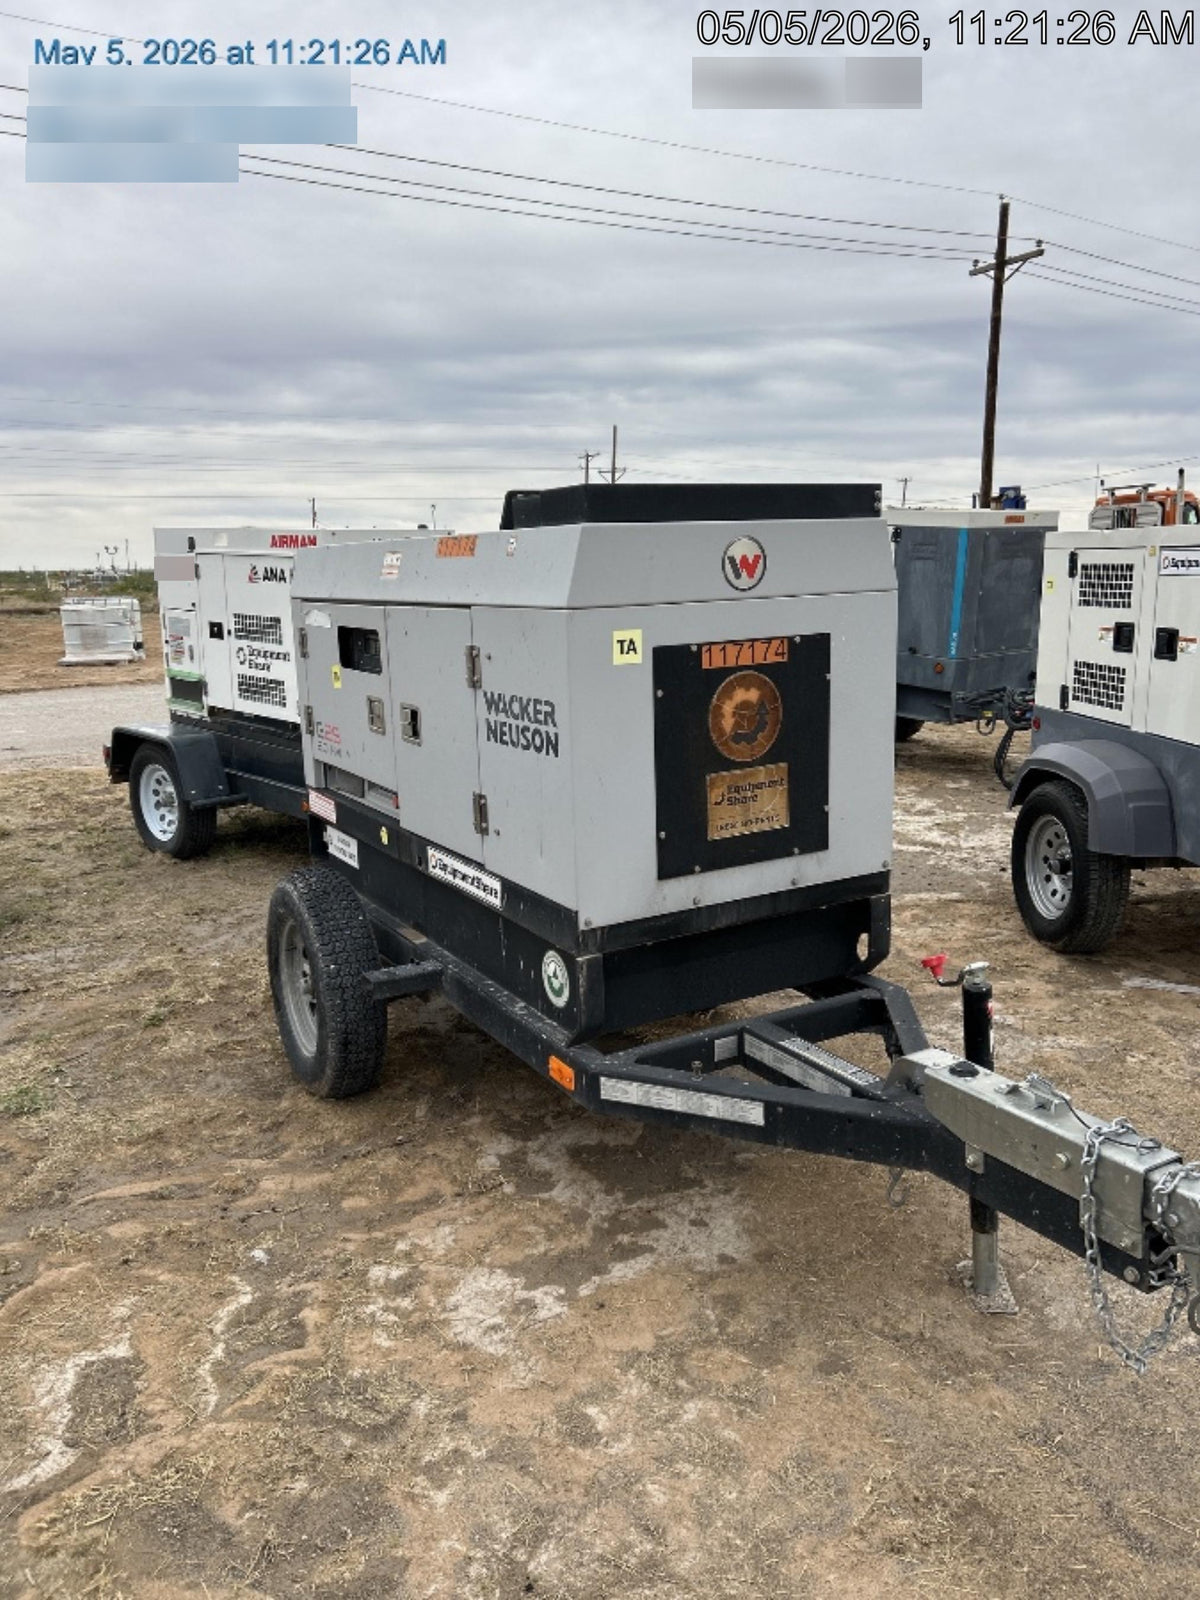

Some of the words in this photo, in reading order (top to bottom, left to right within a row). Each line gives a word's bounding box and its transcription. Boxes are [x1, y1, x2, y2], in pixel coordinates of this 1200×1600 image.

[270, 534, 317, 549] AIRMAN
[262, 566, 287, 584] ANA
[616, 638, 638, 655] TA
[704, 639, 787, 667] 117174
[482, 690, 559, 729] WACKER
[485, 717, 559, 758] NEUSON
